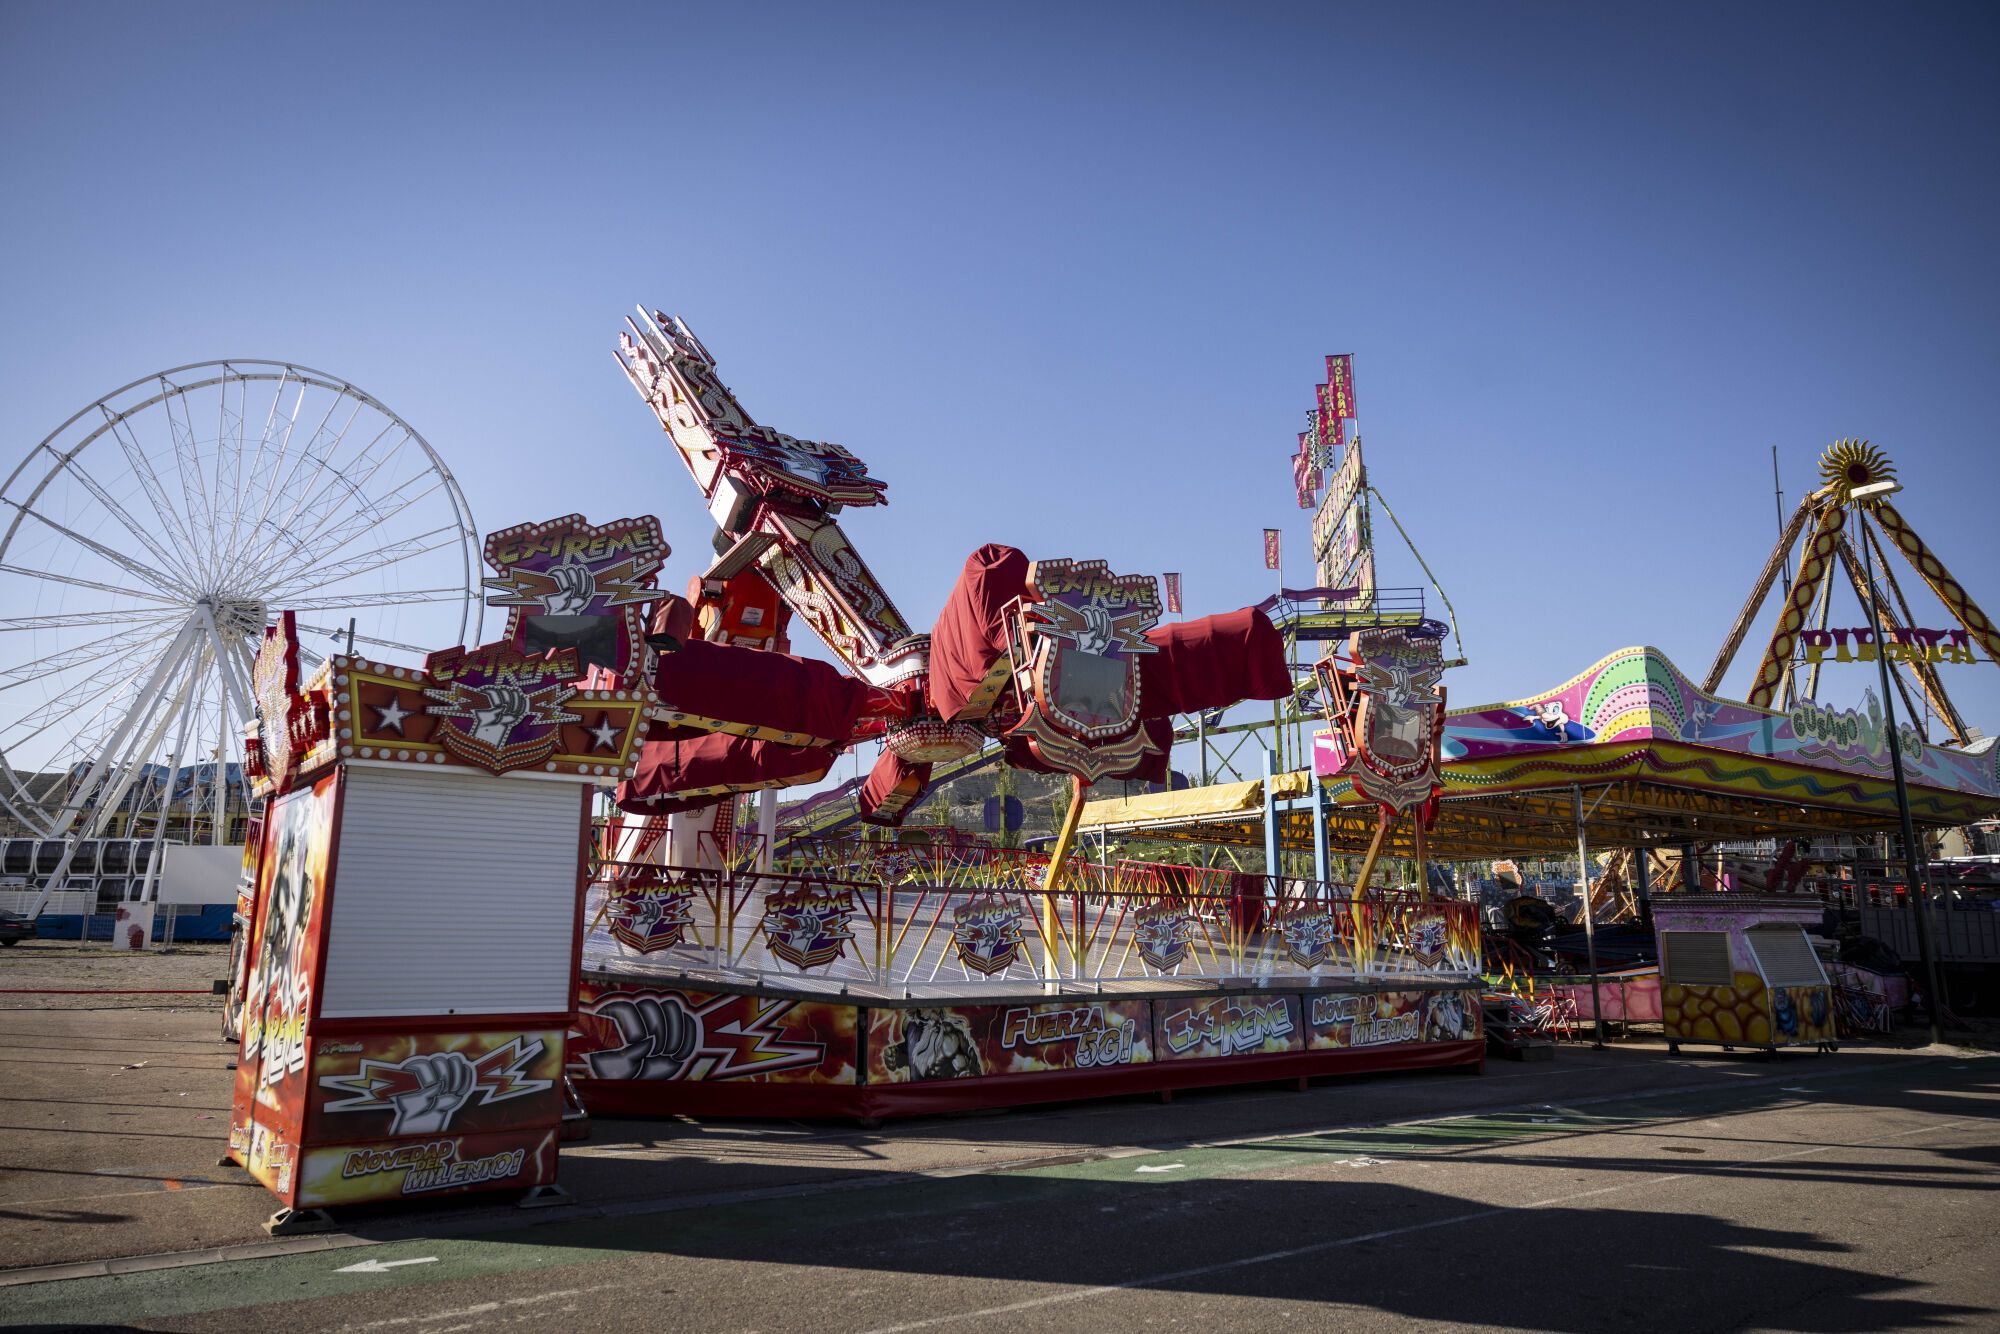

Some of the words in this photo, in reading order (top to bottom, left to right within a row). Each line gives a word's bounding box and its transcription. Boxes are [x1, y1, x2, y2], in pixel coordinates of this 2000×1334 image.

[712, 420, 854, 458] EXTREME
[496, 526, 655, 566] EXTREME
[1043, 569, 1157, 609] EXTREME
[1362, 634, 1439, 668] EXTREME
[1800, 627, 1977, 665] PIRATA
[431, 643, 577, 688] EXTREME
[1792, 704, 1859, 748] GUSANO
[1884, 723, 1922, 760] CO
[610, 877, 693, 901] EXTREME
[765, 888, 853, 916] EXTREME
[954, 898, 1022, 924] EXTREME
[1135, 902, 1190, 925] EXTREME
[1002, 1006, 1104, 1048] FUERZA
[1165, 996, 1293, 1056] EXTREME
[1313, 997, 1377, 1025] NOVEDAD
[1357, 1013, 1373, 1025] DEL
[343, 1140, 454, 1177] NOVEDAD
[414, 1156, 443, 1171] DEL
